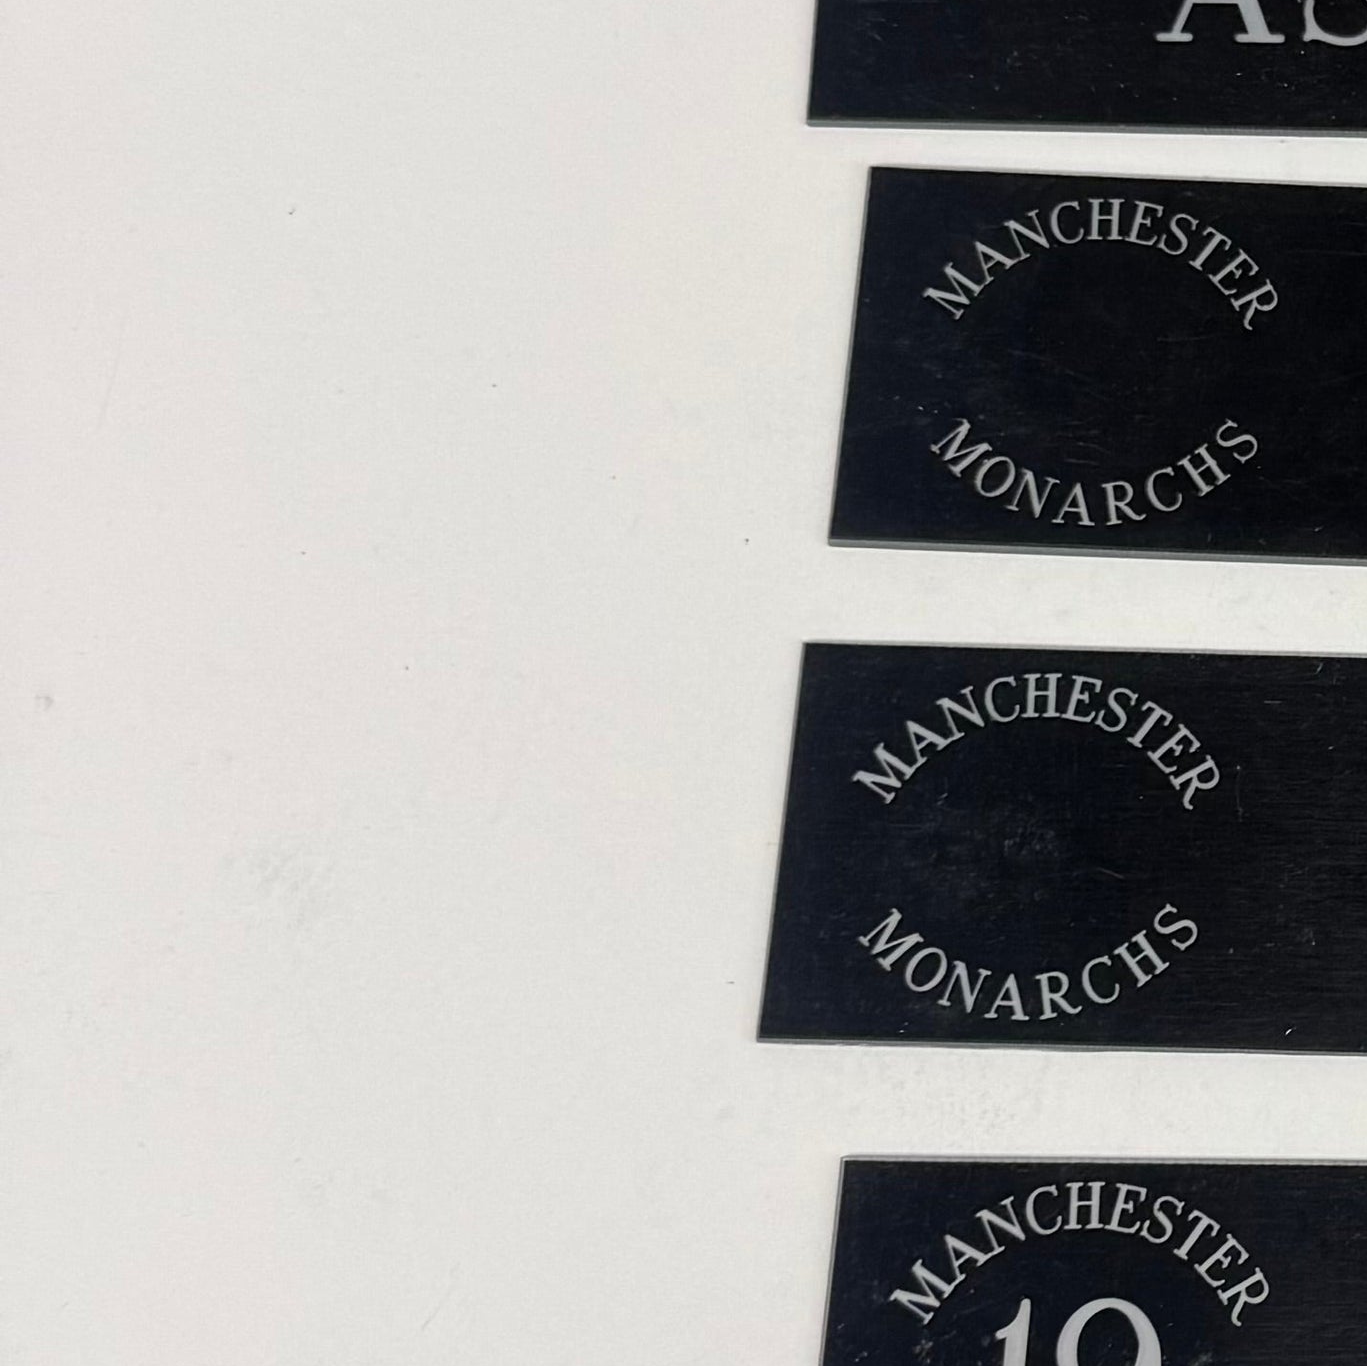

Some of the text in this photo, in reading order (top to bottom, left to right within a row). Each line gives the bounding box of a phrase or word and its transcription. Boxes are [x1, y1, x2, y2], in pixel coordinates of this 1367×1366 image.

[924, 199, 1277, 330] MANCHESTER
[932, 419, 1257, 525] MONARCHS
[853, 674, 1219, 809] MANCHESTER
[859, 904, 1197, 1020] MONARCHS
[890, 1182, 1269, 1327] MANCHESTER
